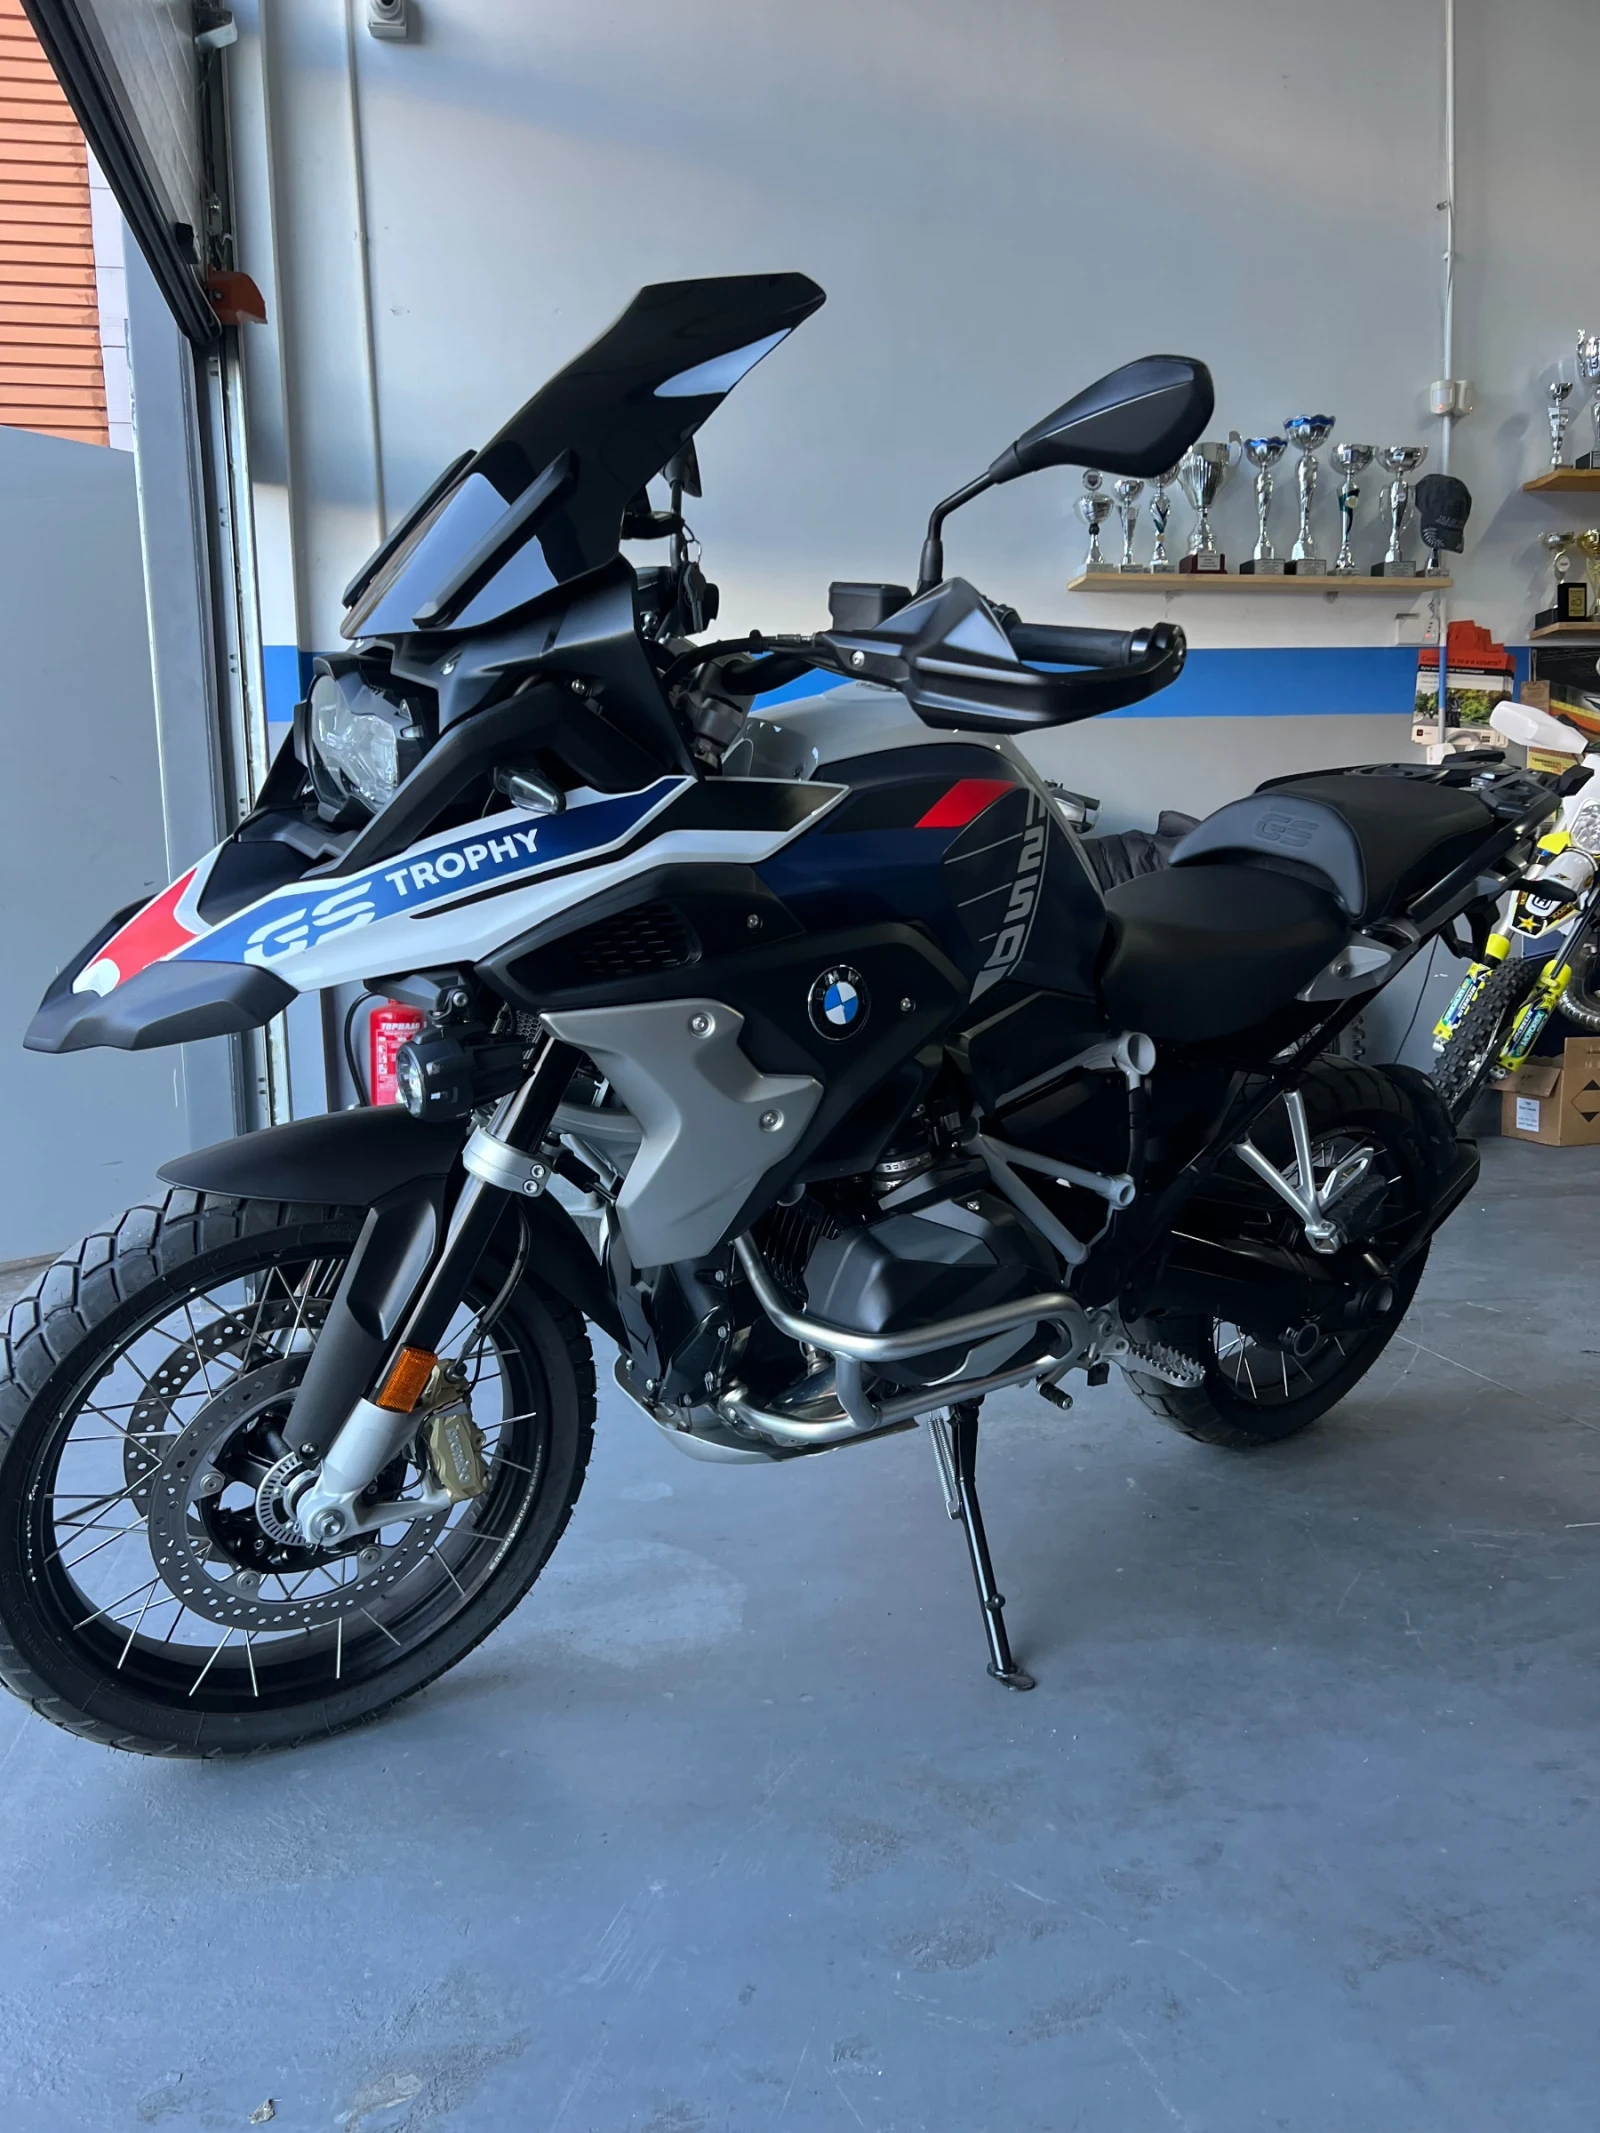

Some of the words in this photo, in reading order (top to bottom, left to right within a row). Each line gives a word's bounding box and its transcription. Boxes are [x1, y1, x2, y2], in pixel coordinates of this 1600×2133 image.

[1254, 812, 1320, 848] GS
[243, 881, 376, 967] GS
[385, 828, 539, 896] TROPHY
[1520, 1010, 1546, 1047] MOTOREX
[446, 1424, 471, 1483] brembo
